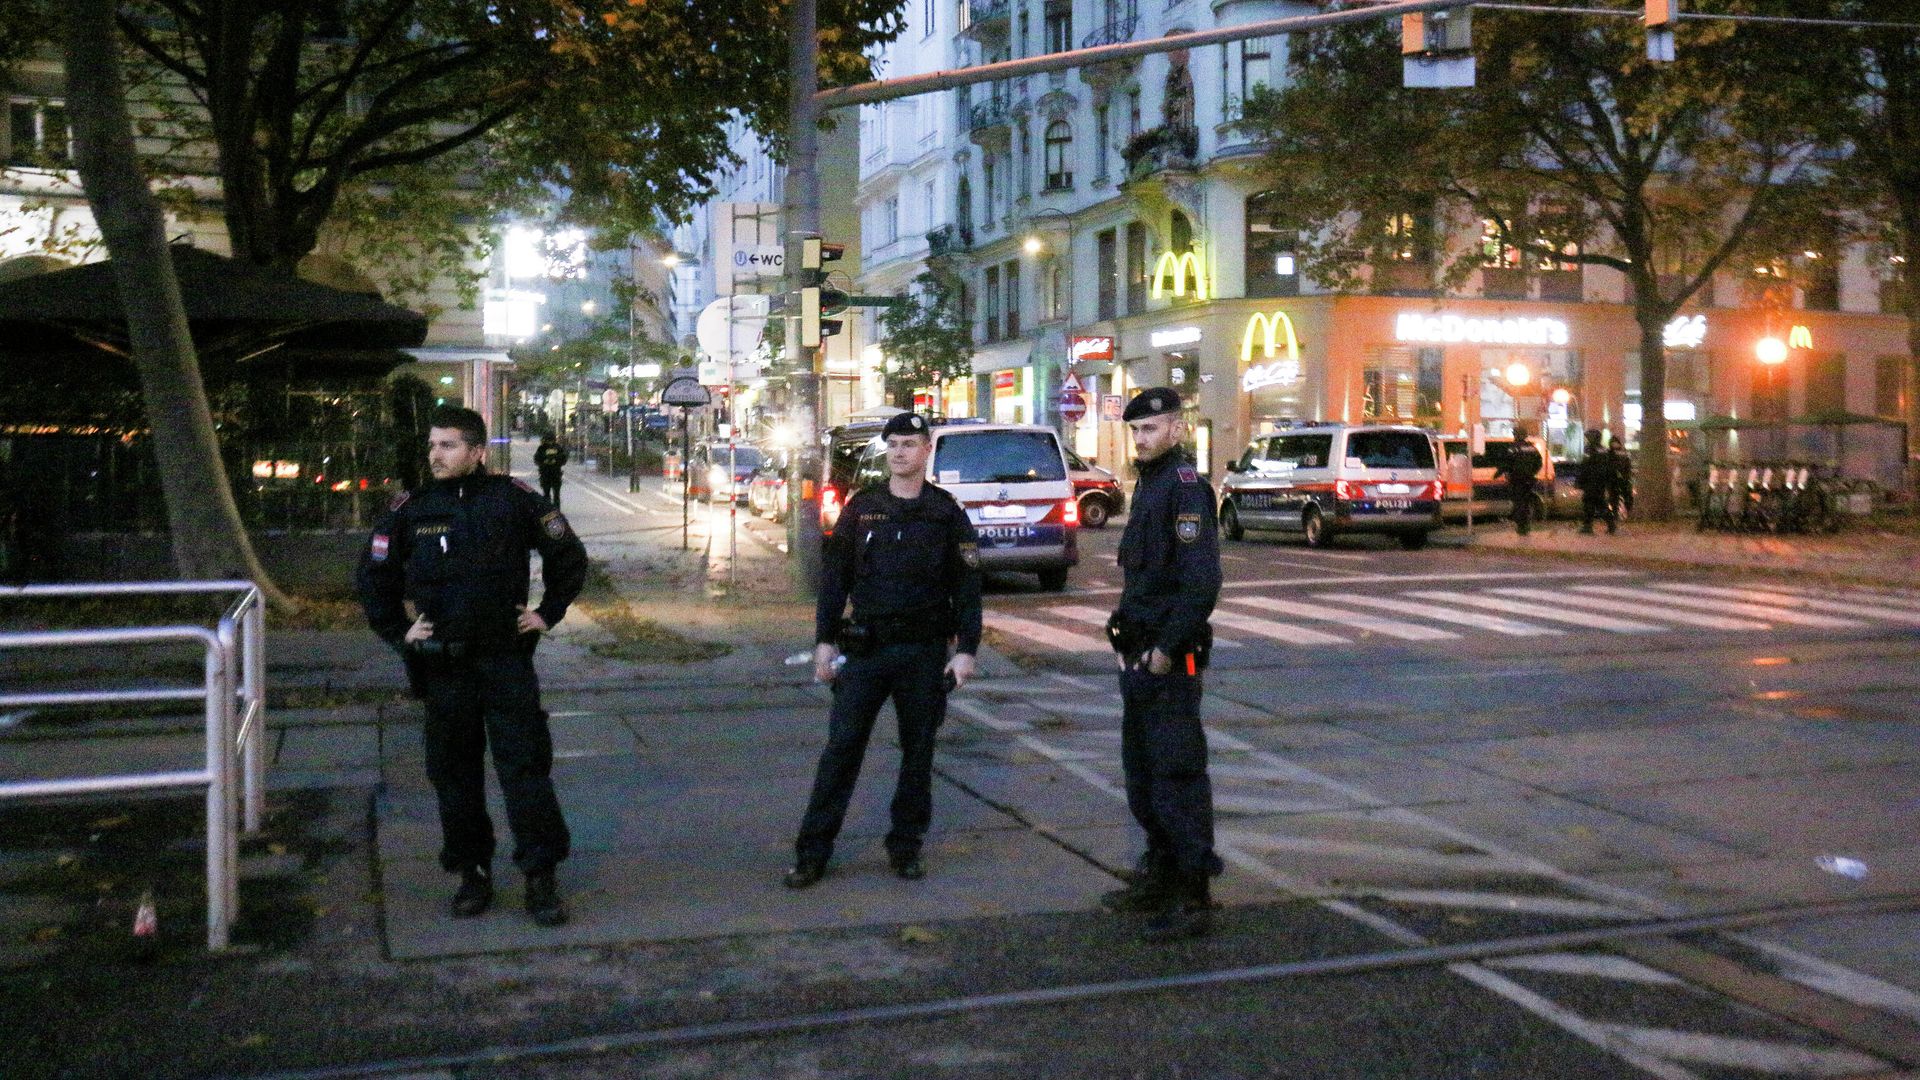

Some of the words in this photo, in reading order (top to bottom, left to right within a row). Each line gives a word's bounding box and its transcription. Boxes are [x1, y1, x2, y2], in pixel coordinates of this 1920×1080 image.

[761, 254, 783, 266] WC
[1396, 313, 1568, 345] McDonald's
[978, 526, 1032, 538] POLIZEI
